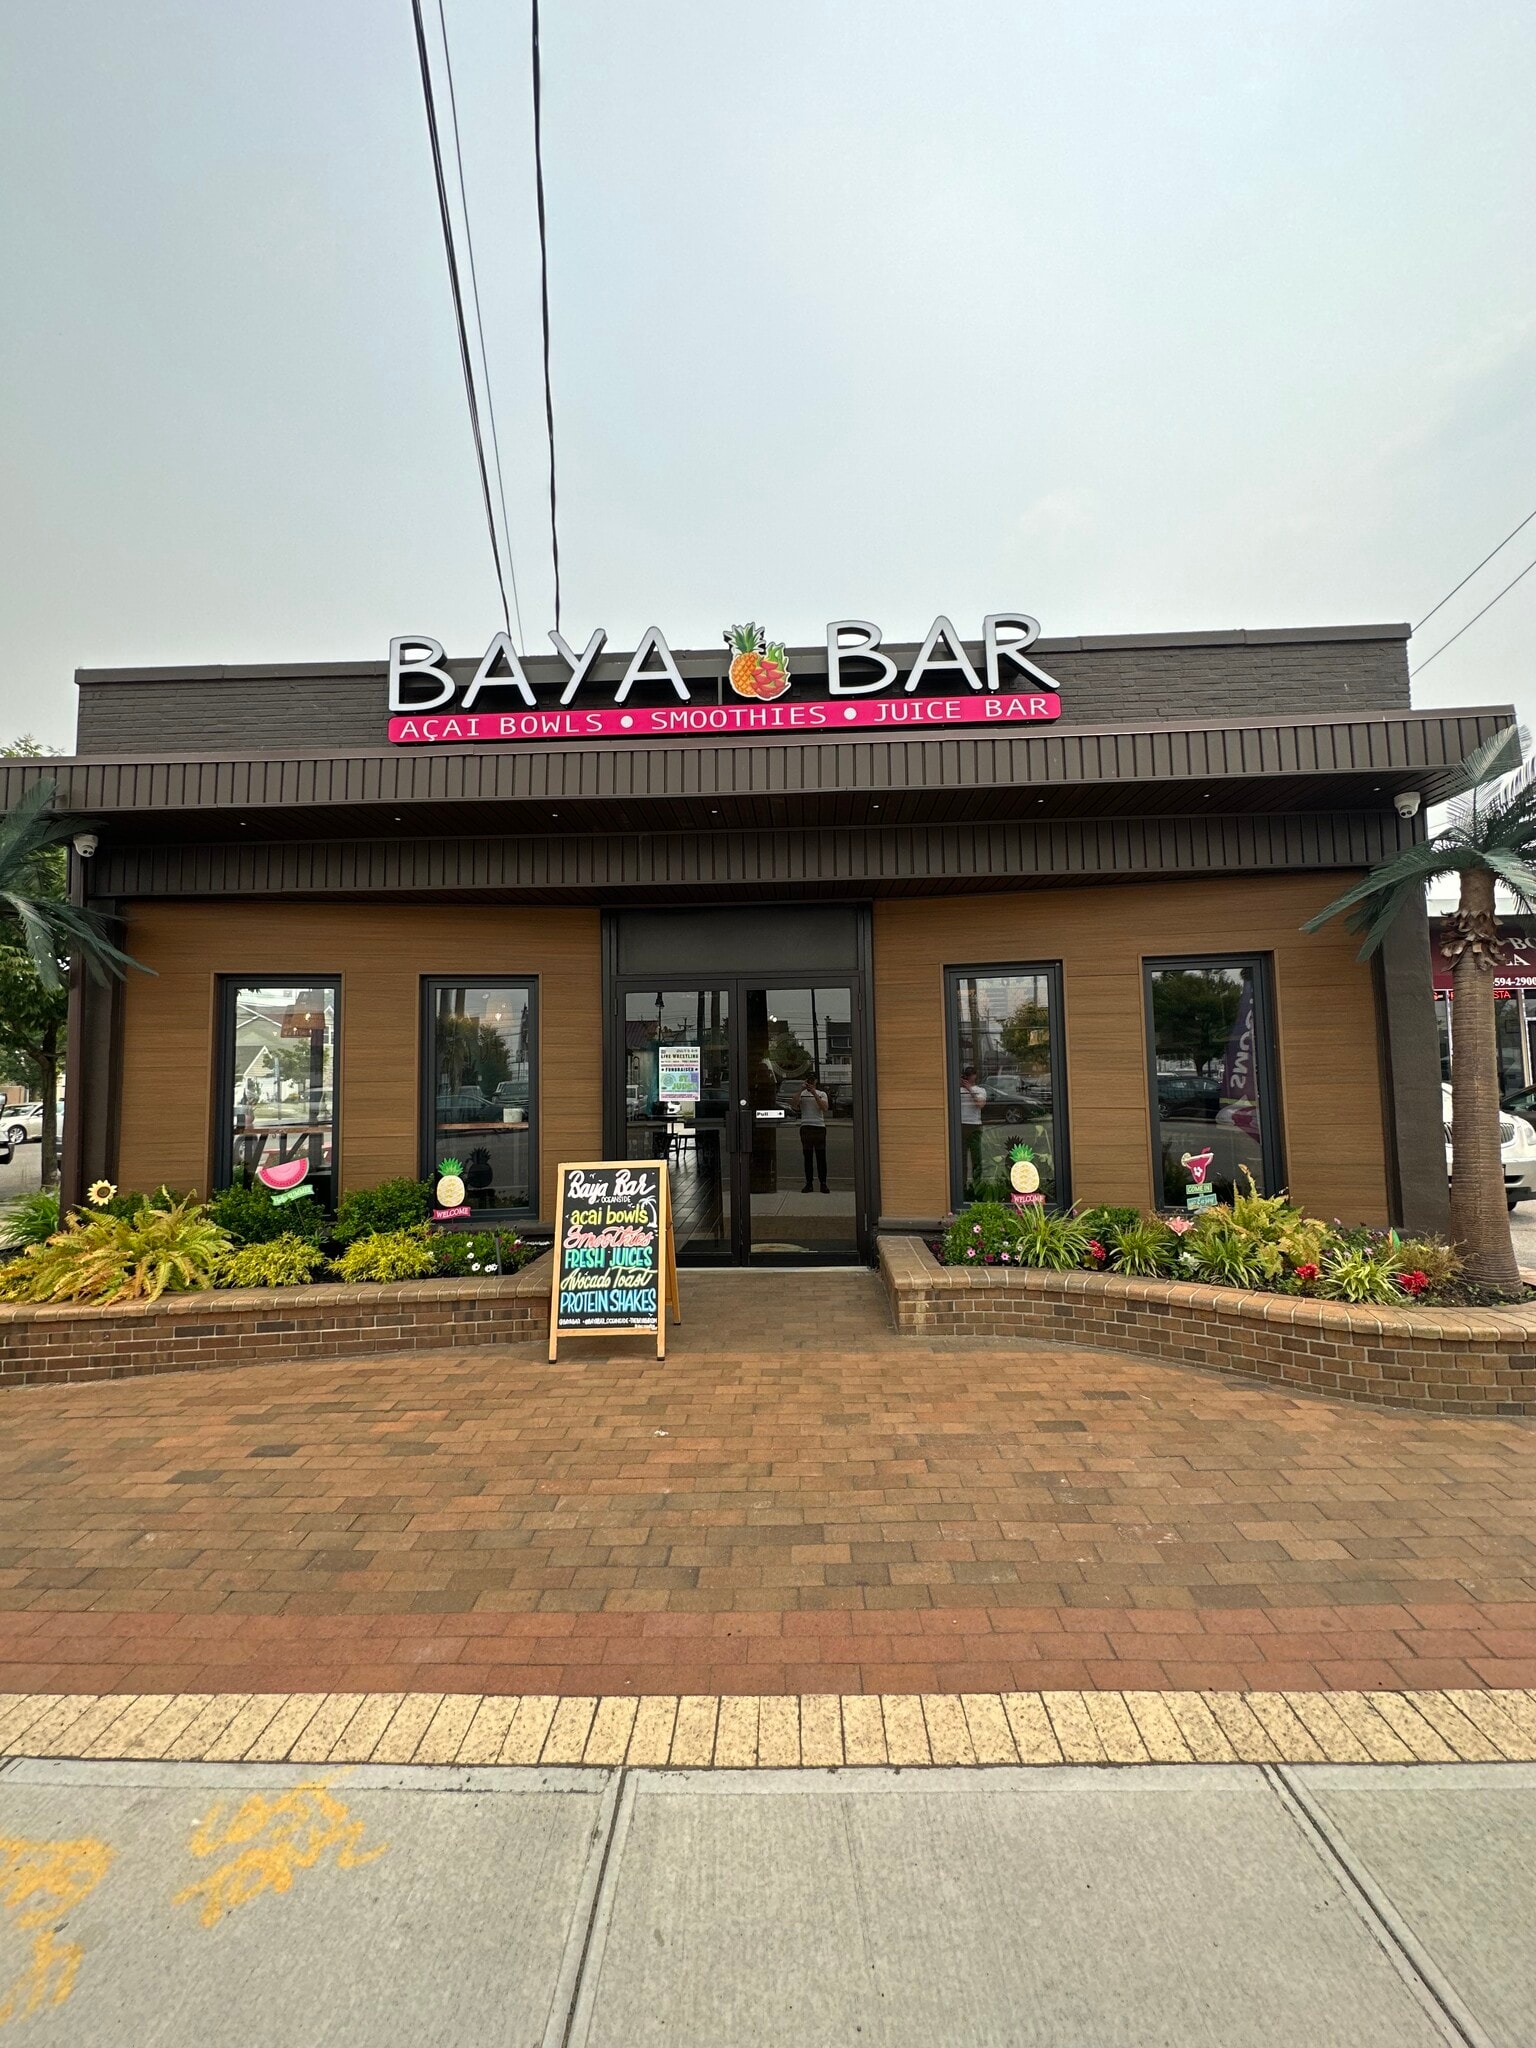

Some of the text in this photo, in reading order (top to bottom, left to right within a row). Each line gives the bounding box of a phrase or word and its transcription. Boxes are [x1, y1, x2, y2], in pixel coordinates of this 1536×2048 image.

[388, 612, 1061, 712] BAYA BAR
[400, 697, 1049, 741] AÇAI BOWLS SMOOTHIES JUICE BAR
[568, 1169, 656, 1204] Baya Bar
[601, 1195, 631, 1203] OCEANSIDE
[436, 1207, 469, 1218] WELCOME
[570, 1204, 649, 1226] acai bowls
[563, 1224, 655, 1249] Smoothies
[565, 1246, 653, 1270] FRESH JUICES
[560, 1266, 658, 1290] Avocado Toast
[560, 1287, 657, 1314] PROTEIN SHAKES
